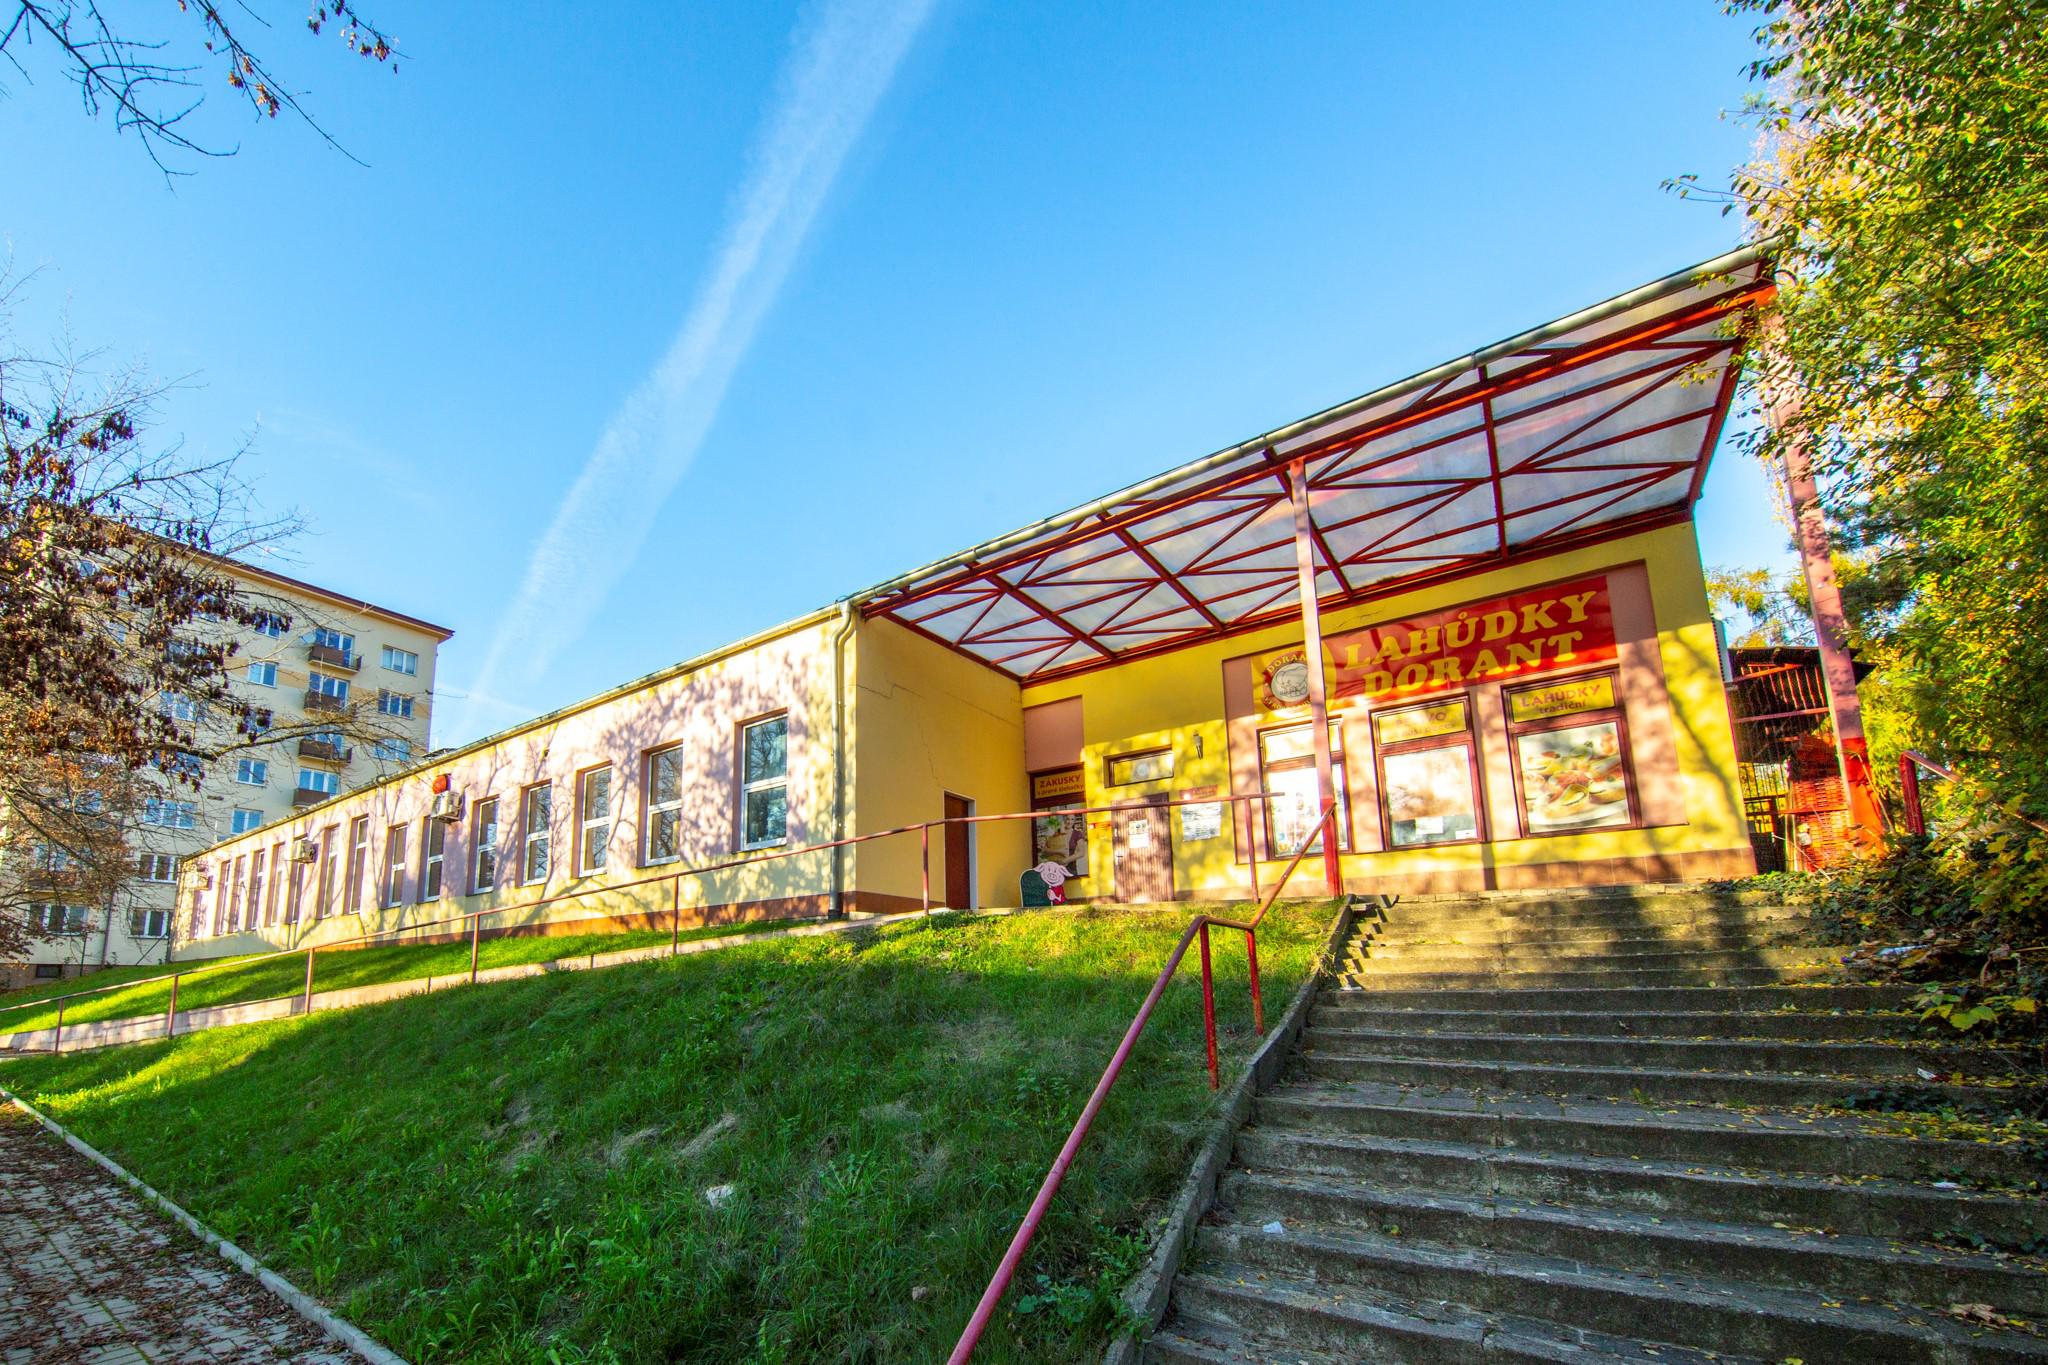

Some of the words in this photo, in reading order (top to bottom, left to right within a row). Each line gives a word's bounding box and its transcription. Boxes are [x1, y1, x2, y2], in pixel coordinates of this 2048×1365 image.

[1345, 591, 1597, 670] LAHŮDKY
[1266, 654, 1308, 673] DORAN
[1362, 630, 1583, 697] DORANT
[1039, 774, 1081, 788] ZÁKUSKY
